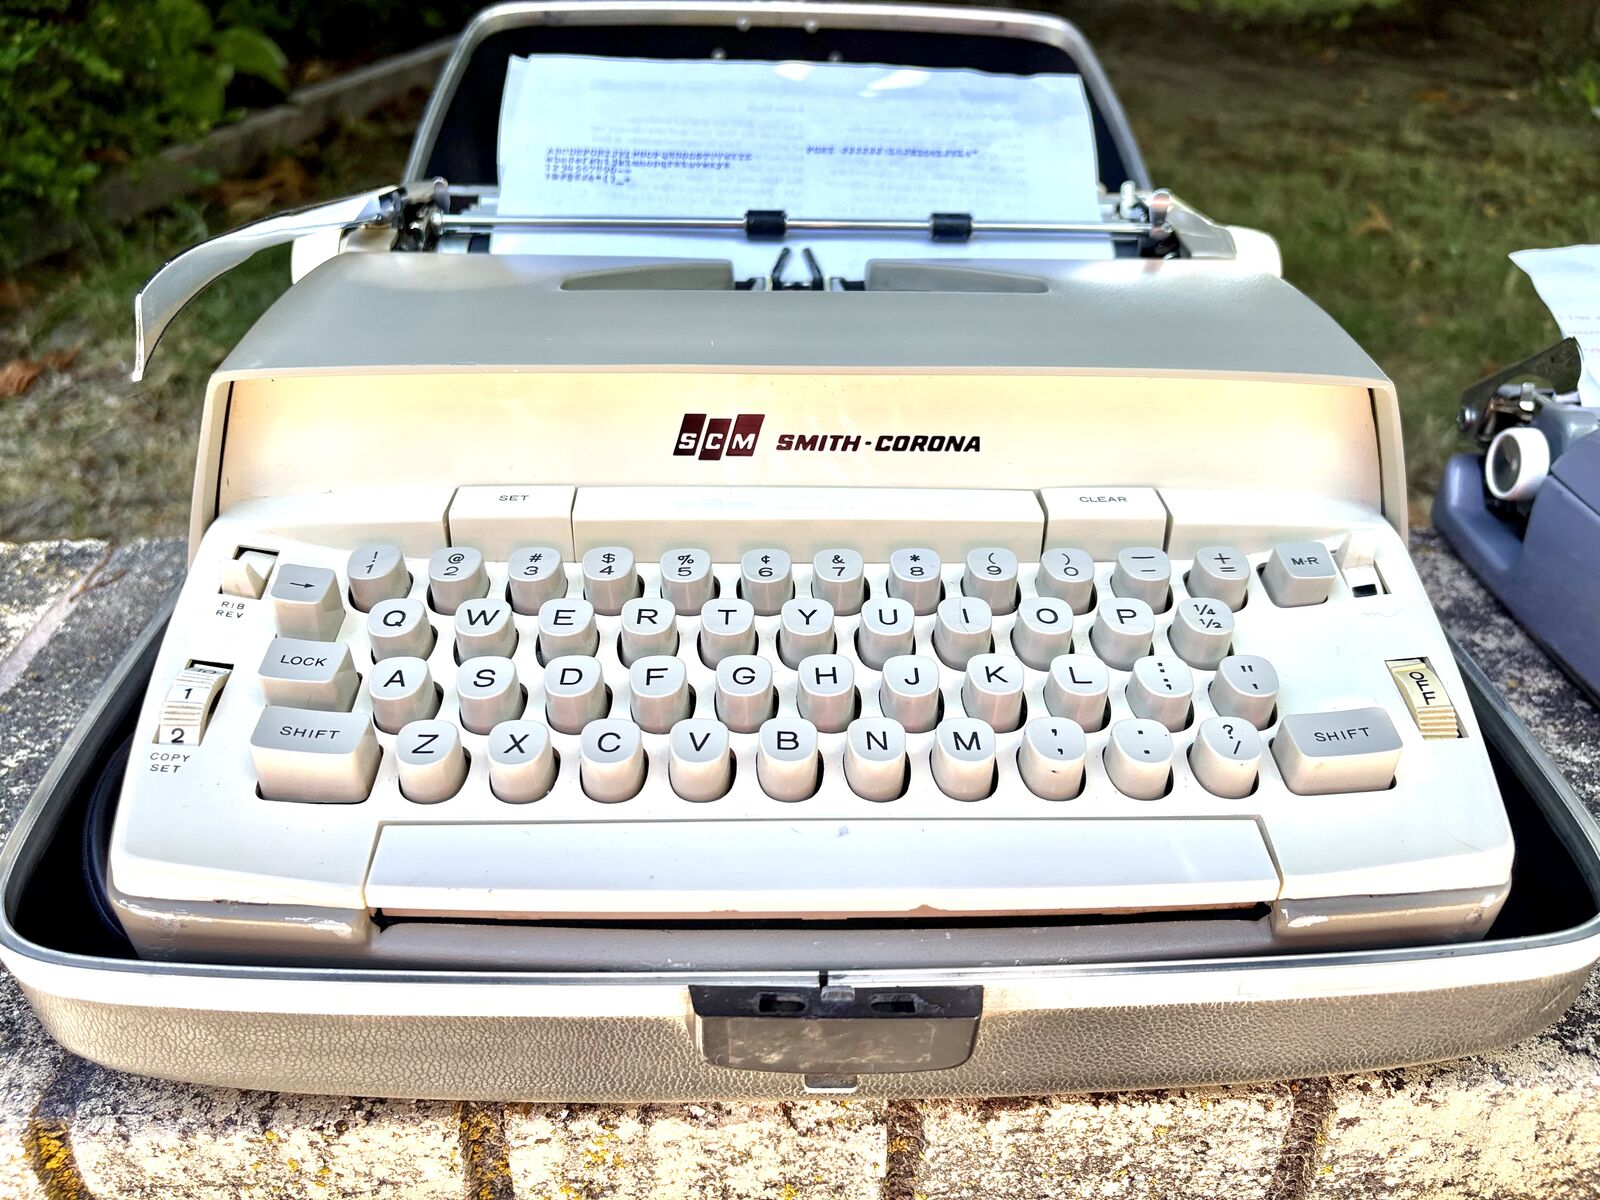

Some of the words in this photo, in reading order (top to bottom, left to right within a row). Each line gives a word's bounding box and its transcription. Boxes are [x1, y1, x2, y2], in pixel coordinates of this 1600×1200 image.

[372, 552, 378, 562] !
[449, 554, 464, 564] @
[530, 554, 542, 562] #
[602, 553, 615, 563] $
[678, 555, 694, 565] %
[761, 555, 770, 564] ¢
[833, 555, 844, 563] &
[989, 553, 995, 564] (
[1063, 554, 1070, 565] )
[1214, 553, 1230, 564] +
[1291, 557, 1318, 565] M-R
[366, 564, 373, 573] 1
[444, 567, 458, 575] 2
[524, 566, 538, 575] 3
[600, 566, 614, 574] 4
[678, 567, 691, 576] 5
[759, 568, 773, 577] 6
[833, 567, 845, 576] 7
[911, 567, 924, 576] 8
[987, 566, 1001, 575] 9
[1064, 567, 1078, 576] 0
[221, 600, 245, 611] RIB
[215, 609, 244, 619] REV
[383, 610, 406, 626] Q
[467, 610, 500, 625] W
[554, 610, 575, 625] E
[637, 609, 658, 624] R
[718, 610, 737, 625] T
[798, 609, 817, 625] Y
[879, 609, 897, 625] U
[963, 609, 969, 623] I
[1037, 609, 1058, 624] O
[1117, 609, 1136, 624] P
[281, 655, 326, 666] LOCK
[384, 670, 405, 687] A
[474, 669, 495, 687] S
[560, 668, 582, 685] D
[646, 668, 668, 685] F
[733, 667, 755, 684] G
[816, 667, 837, 684] H
[905, 668, 919, 685] J
[985, 666, 1008, 682] K
[1069, 667, 1092, 683] L
[186, 689, 192, 699] 1
[1409, 672, 1435, 705] OFF
[171, 728, 184, 743] 2
[280, 727, 339, 738] SHIFT
[1223, 725, 1233, 739] ?
[1315, 728, 1368, 741] SHIFT
[412, 735, 438, 753] Z
[504, 735, 528, 753] X
[598, 733, 620, 752] C
[690, 733, 710, 751] V
[777, 731, 799, 750] B
[867, 732, 887, 750] N
[953, 732, 980, 750] M
[1234, 741, 1241, 754] /
[150, 752, 190, 762] COPY
[150, 764, 181, 773] SET
